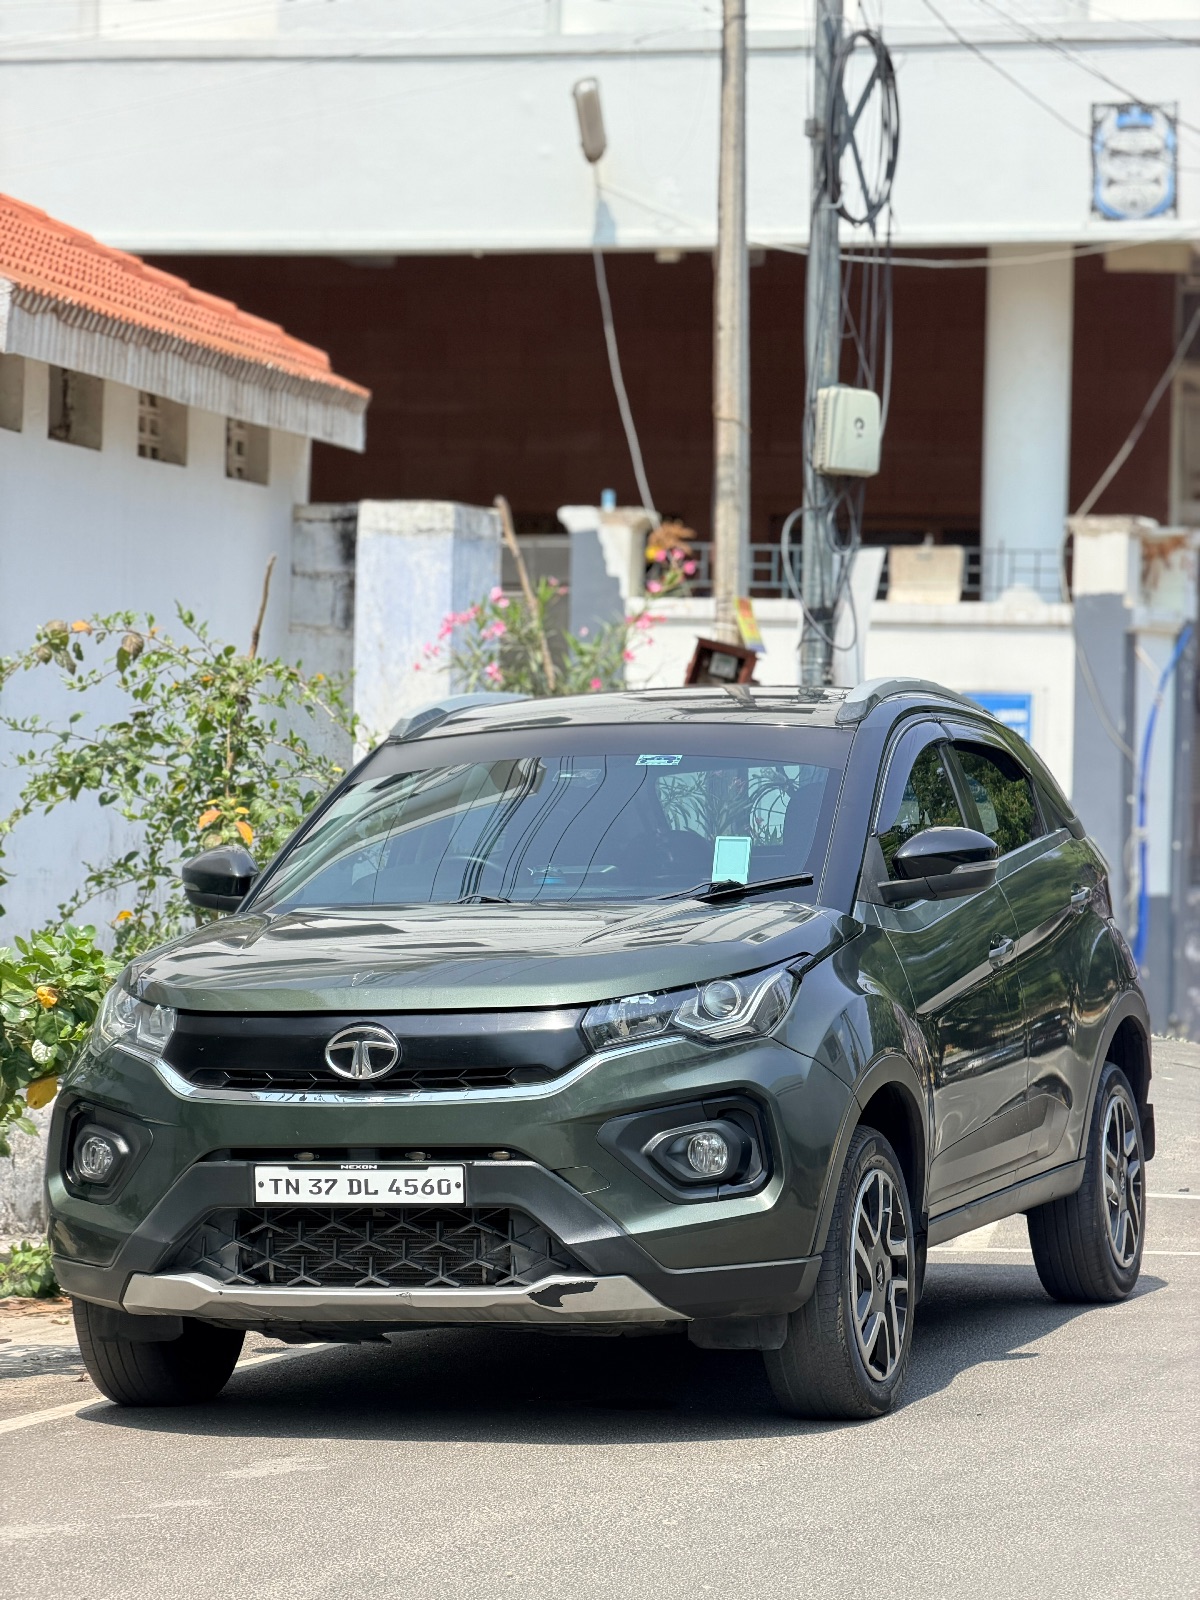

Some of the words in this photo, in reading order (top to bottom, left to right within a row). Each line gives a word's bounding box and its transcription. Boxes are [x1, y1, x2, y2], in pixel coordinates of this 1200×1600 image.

[268, 1178, 300, 1195] TN
[308, 1178, 338, 1196] 37
[346, 1178, 379, 1196] DL
[387, 1178, 452, 1196] 4560
